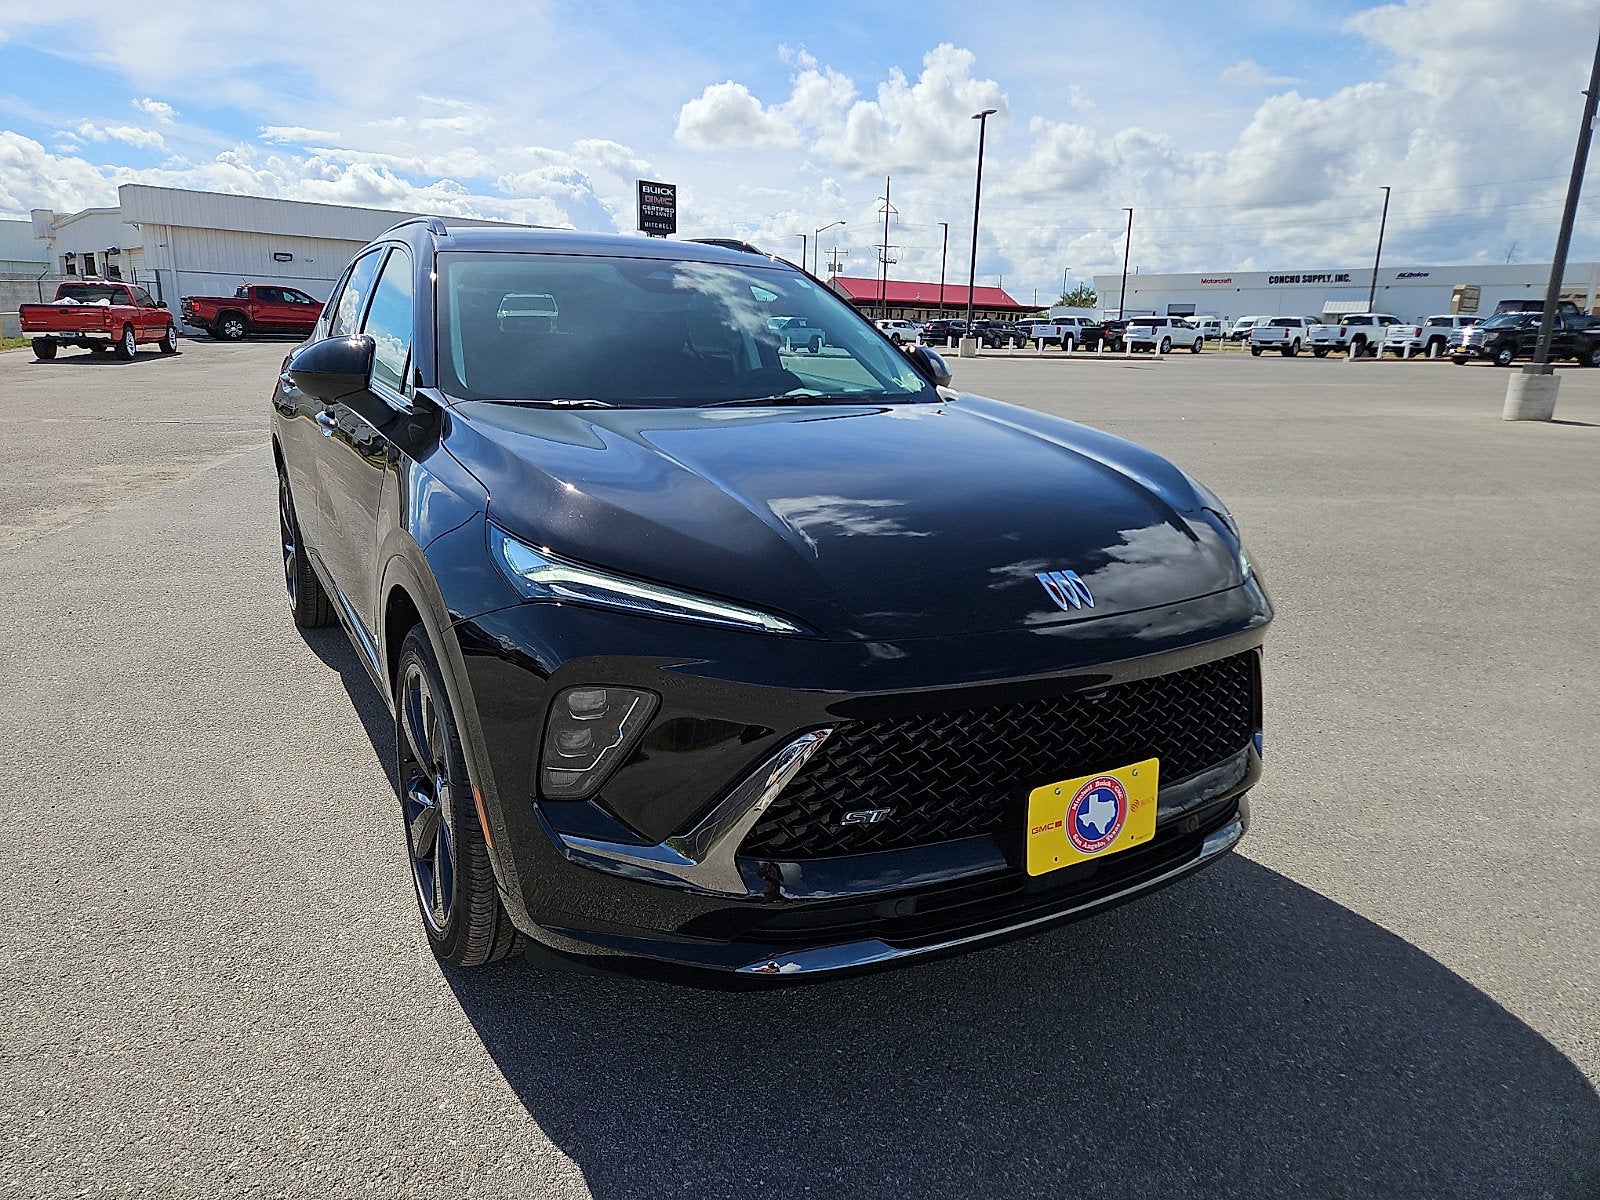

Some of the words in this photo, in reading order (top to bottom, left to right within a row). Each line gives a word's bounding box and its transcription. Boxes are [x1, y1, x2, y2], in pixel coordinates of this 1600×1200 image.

[642, 185, 674, 196] BUICK
[644, 195, 673, 205] GMC
[642, 205, 674, 213] CERTIFIED
[644, 221, 672, 229] MITCHELL
[1269, 275, 1300, 284] CONCHO
[1302, 274, 1333, 283] SUPPLY,
[1335, 274, 1351, 282] INC.
[841, 807, 891, 825] ST
[1031, 822, 1055, 835] GMC
